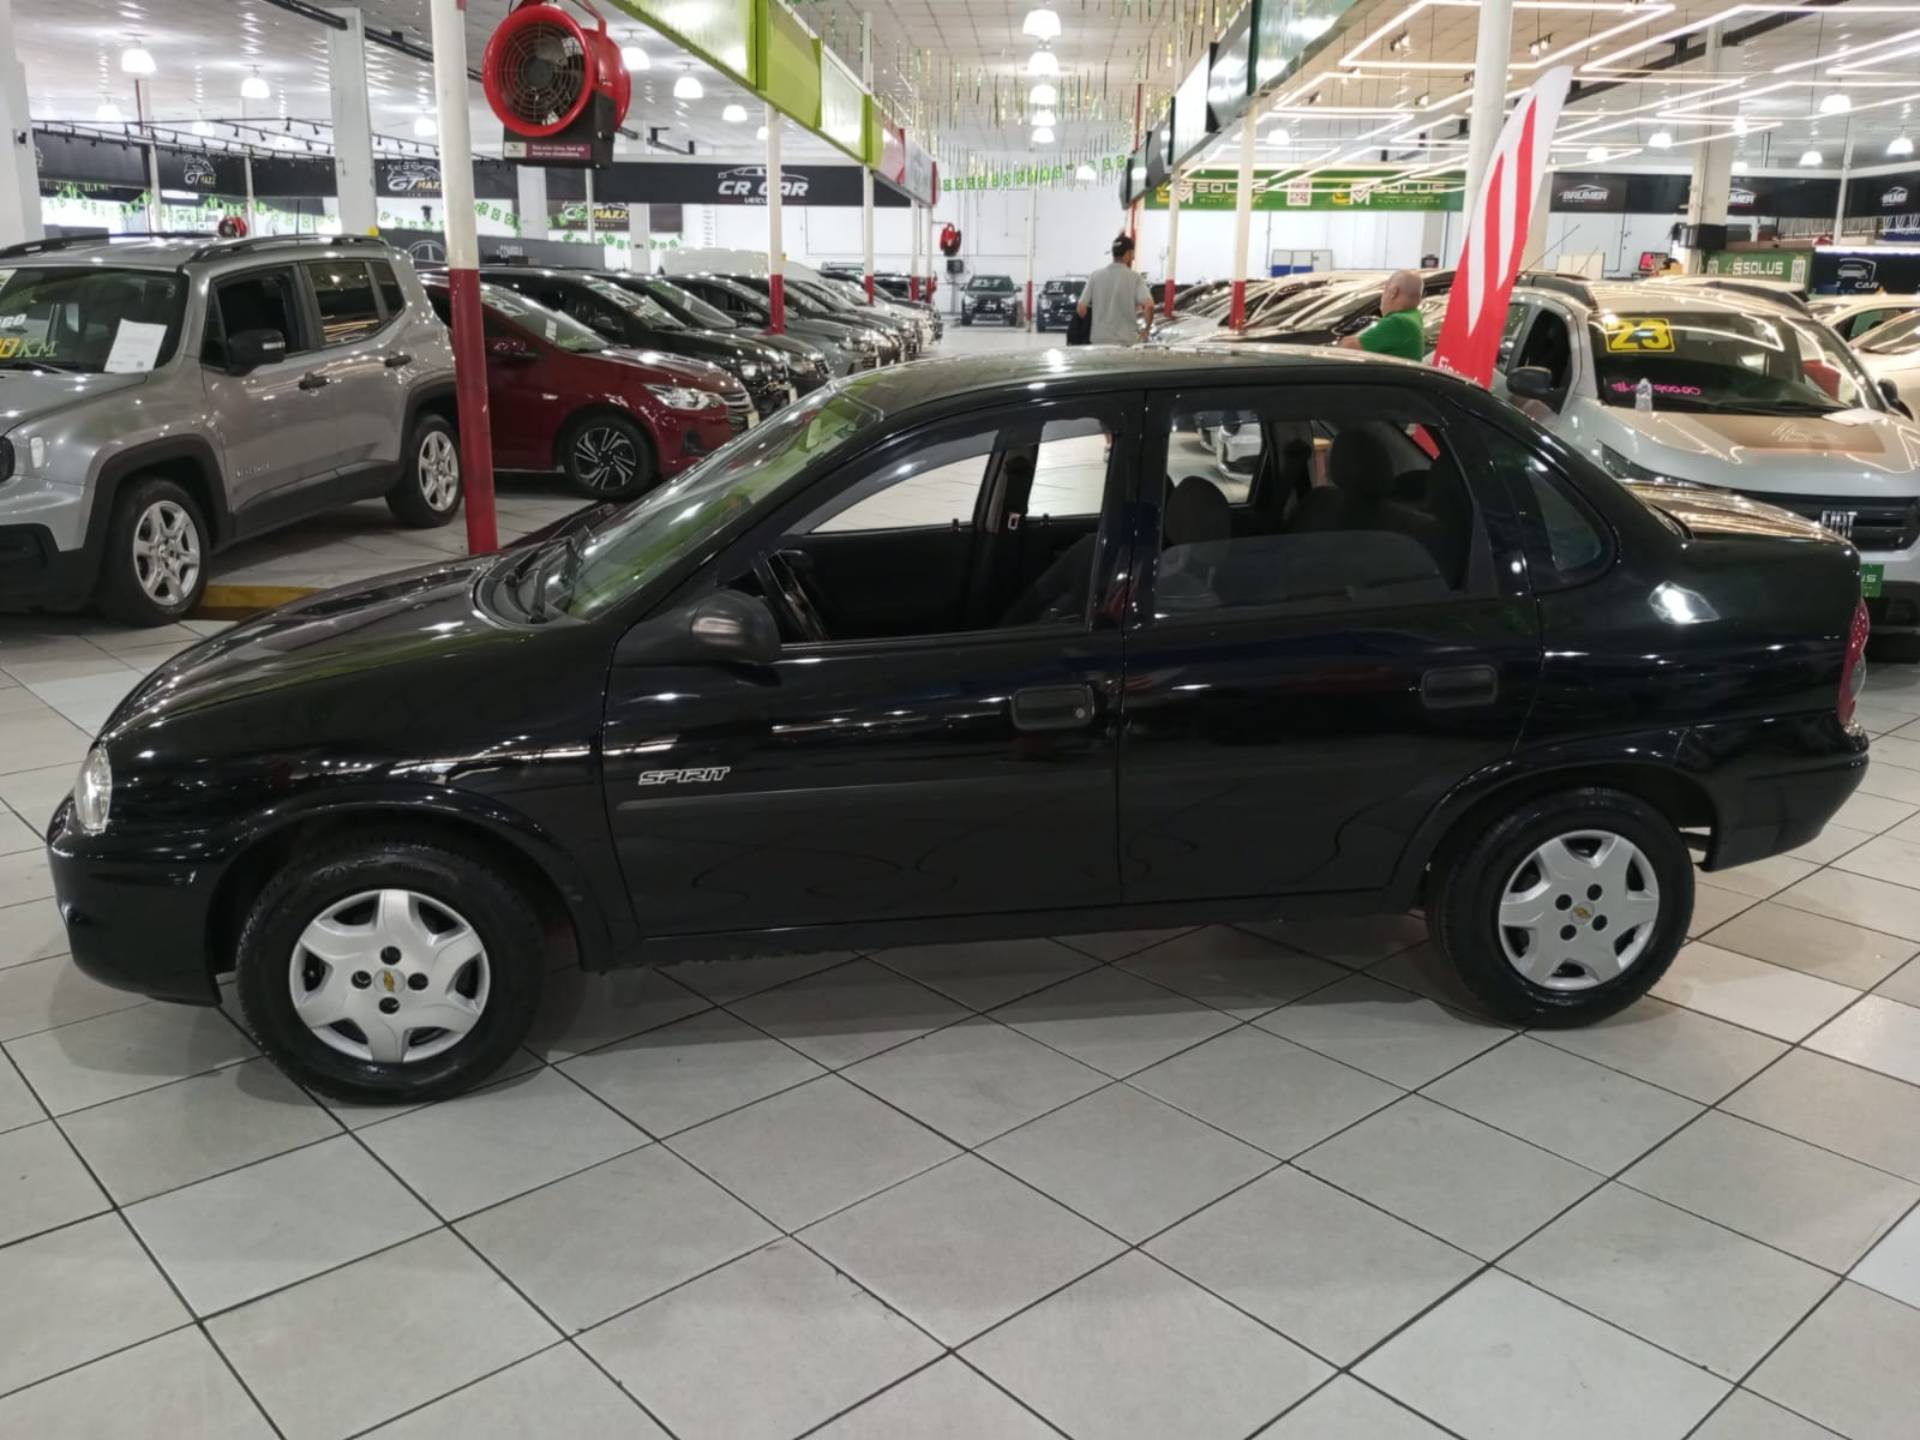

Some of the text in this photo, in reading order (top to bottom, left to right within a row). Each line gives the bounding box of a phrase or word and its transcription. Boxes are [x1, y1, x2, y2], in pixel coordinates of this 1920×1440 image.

[718, 181, 751, 195] CR
[1854, 281, 1880, 289] CAR
[1609, 320, 1670, 350] 23
[638, 766, 731, 786] SPIRIT
